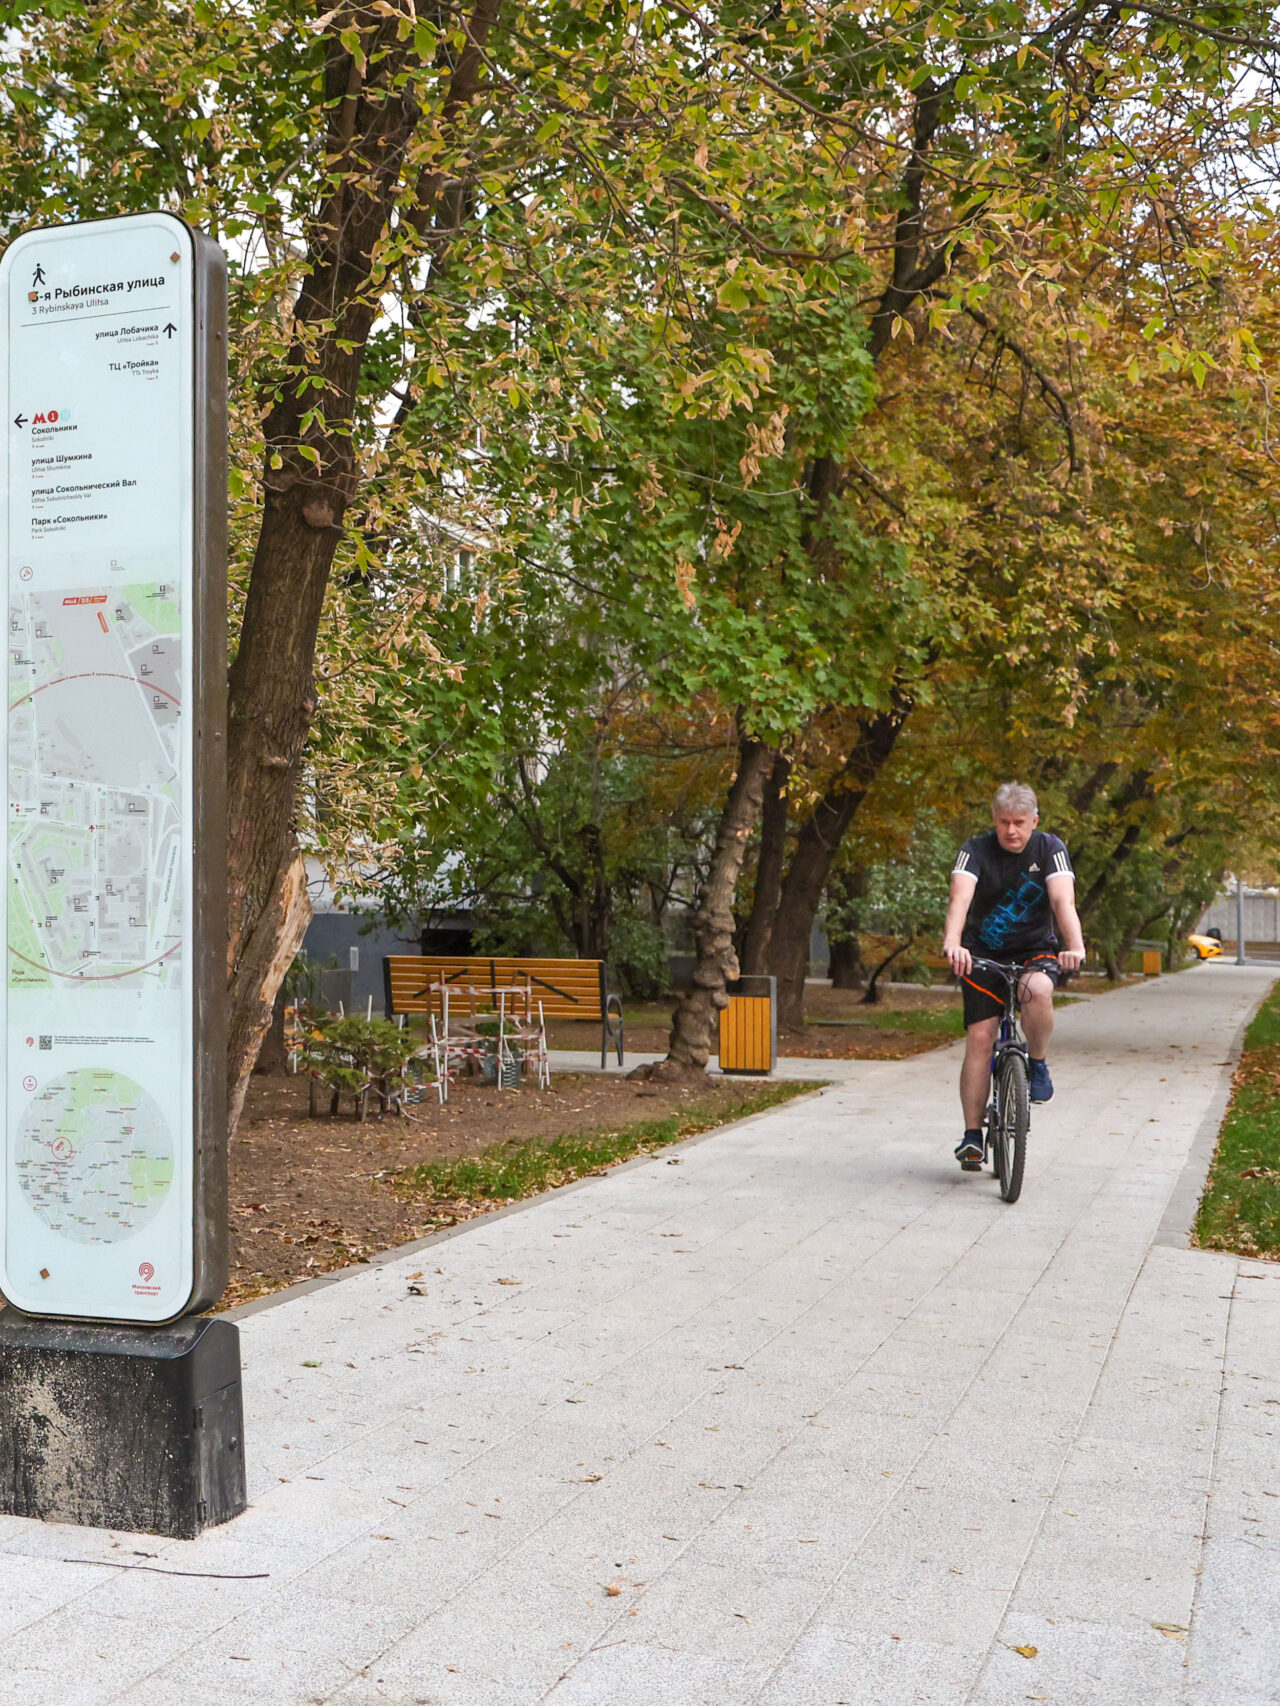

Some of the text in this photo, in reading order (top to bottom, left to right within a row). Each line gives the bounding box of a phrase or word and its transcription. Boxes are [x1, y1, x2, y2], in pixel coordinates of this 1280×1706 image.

[55, 281, 124, 299] Рыбинская
[127, 276, 165, 292] улица
[32, 299, 109, 315] 3 Rybinskaya Ulitsa
[95, 325, 159, 340] улица Лобачика
[109, 360, 159, 371] ТЦ «Тройка»
[31, 424, 78, 435] Сокольники
[31, 453, 92, 467] улица Шумкина
[31, 479, 137, 498] улица Сокольнический Вал
[31, 513, 108, 527] Парк «Сокольники»
